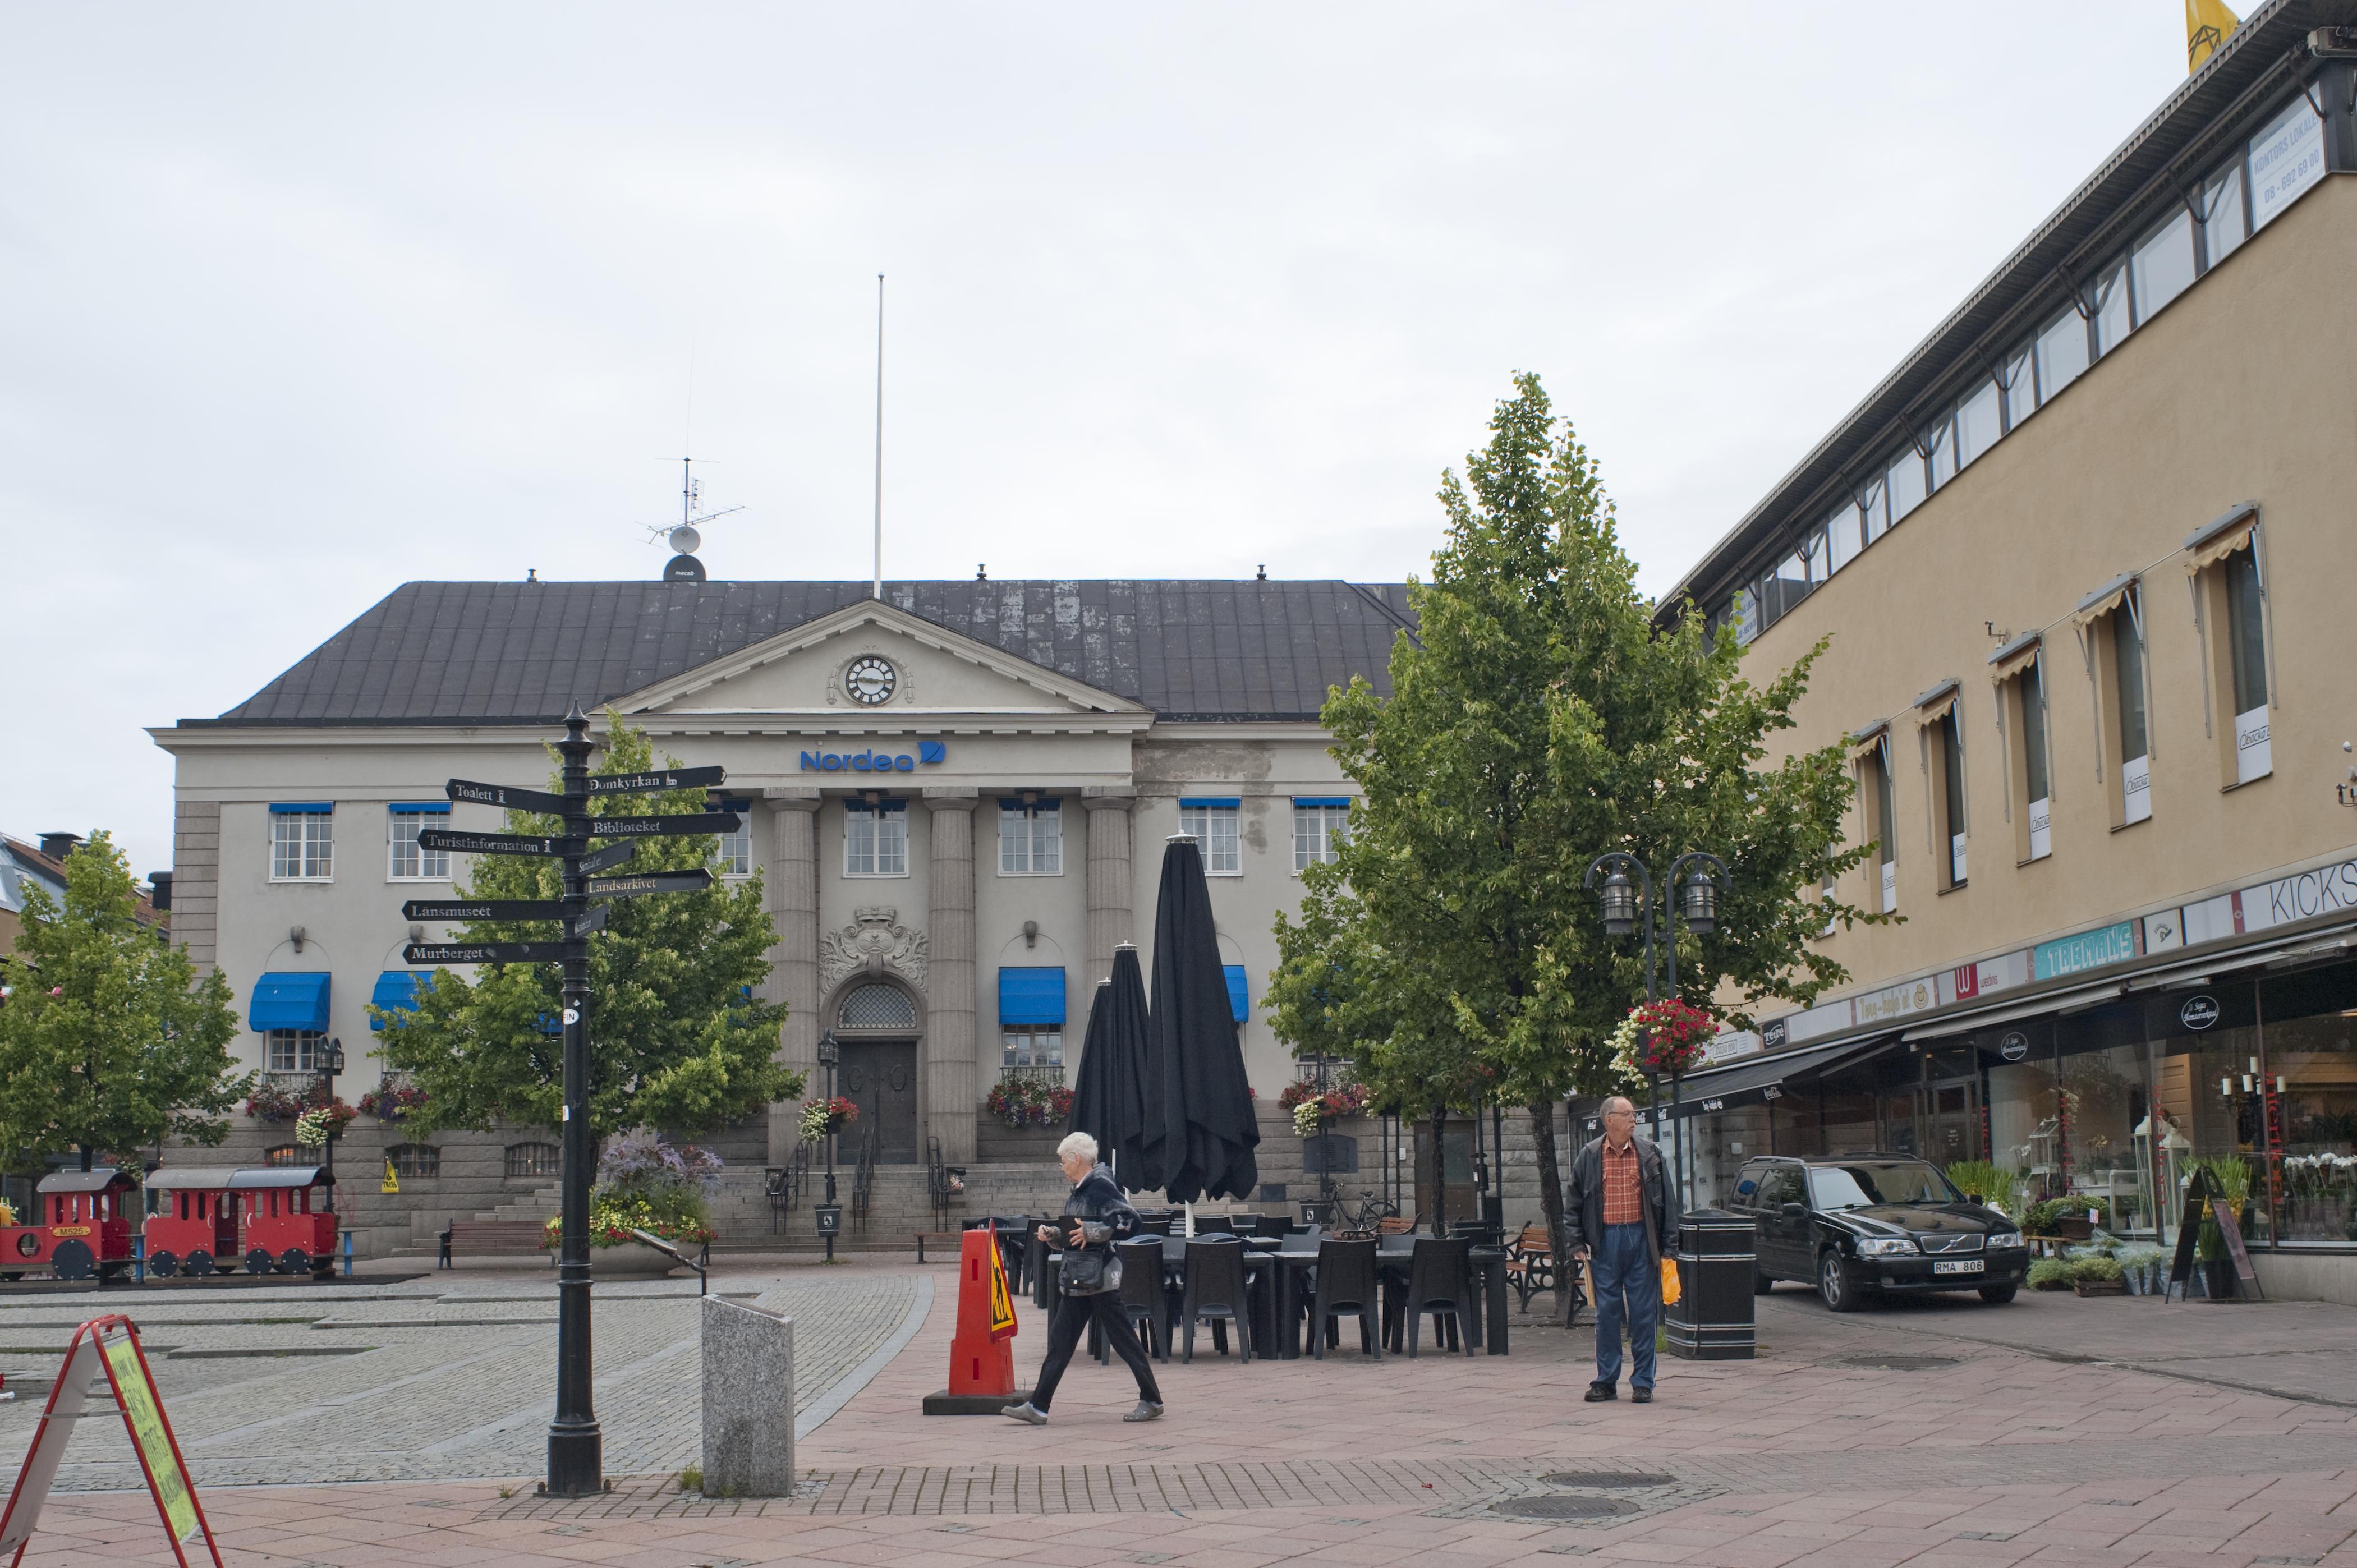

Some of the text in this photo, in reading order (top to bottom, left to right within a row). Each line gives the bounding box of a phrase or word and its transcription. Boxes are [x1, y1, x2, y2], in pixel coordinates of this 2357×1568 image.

[2254, 137, 2289, 175] KONTORS
[2264, 185, 2276, 203] 08
[2281, 168, 2297, 191] 692
[2298, 159, 2308, 177] 69
[2309, 148, 2319, 170] 00
[800, 749, 914, 771] Nordea
[456, 784, 493, 801] Toalett
[590, 776, 660, 792] Domkyrkan
[593, 820, 661, 834] Biblioteket
[427, 834, 539, 853] Turistinformation
[588, 878, 657, 893] Landsarkivet
[2269, 862, 2357, 924] KICKS
[412, 946, 484, 961] Murberget
[2047, 926, 2133, 976] TREMANS
[1936, 1261, 1983, 1272] RMA 806
